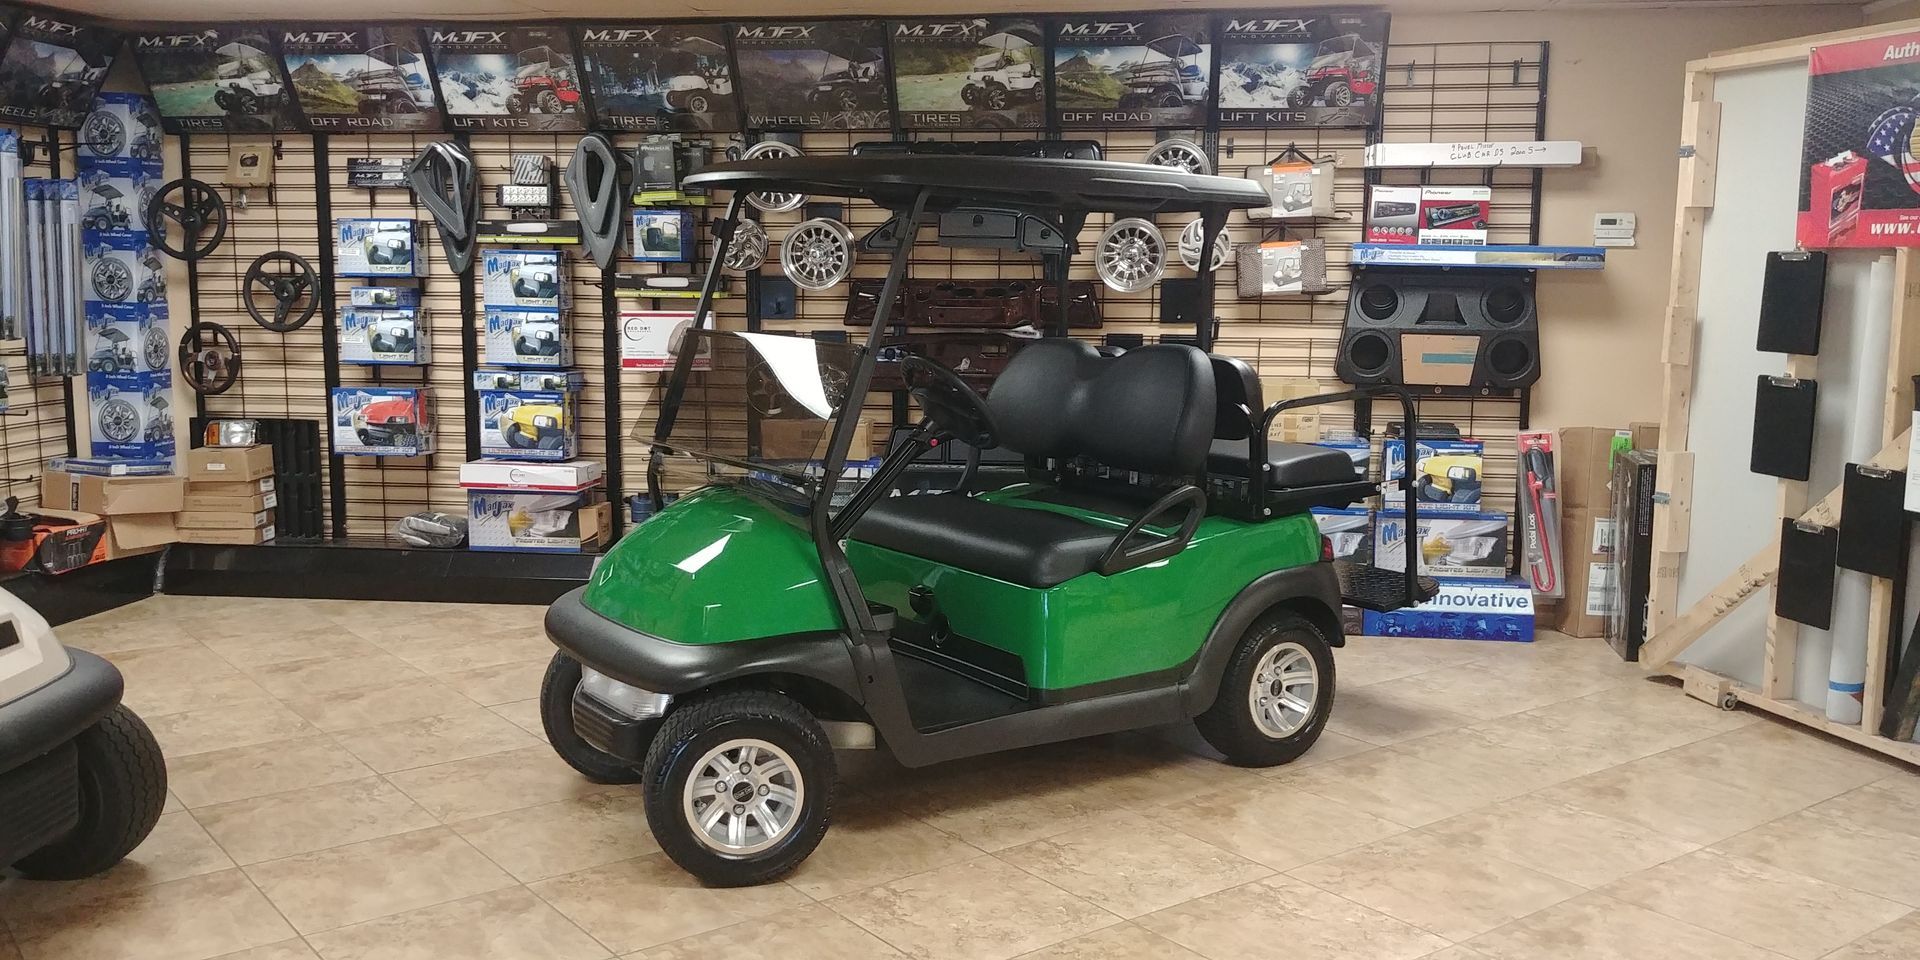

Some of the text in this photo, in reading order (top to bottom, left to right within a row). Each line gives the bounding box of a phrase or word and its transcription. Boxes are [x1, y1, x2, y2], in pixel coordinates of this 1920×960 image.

[1060, 22, 1145, 36] MJFX
[1225, 19, 1316, 32] MJFX
[432, 31, 507, 43] MJFX
[582, 28, 662, 41] MJFX
[736, 26, 817, 39] MJFX
[179, 118, 223, 128] TIRES
[310, 117, 394, 127] OFF ROAD
[453, 117, 529, 127] LIFT KITS
[609, 115, 657, 126] TIRES
[750, 115, 821, 125] WHEELS
[911, 113, 961, 123] TIRES
[1062, 112, 1153, 122] OFF ROAD
[1220, 111, 1307, 122] LIFT KITS
[487, 257, 521, 275] MadJax
[345, 313, 379, 331] MadJax
[489, 315, 524, 333] MadJax
[485, 394, 520, 414] MadJax
[473, 497, 515, 519] MadJax
[1528, 513, 1537, 549] Pedal Lock
